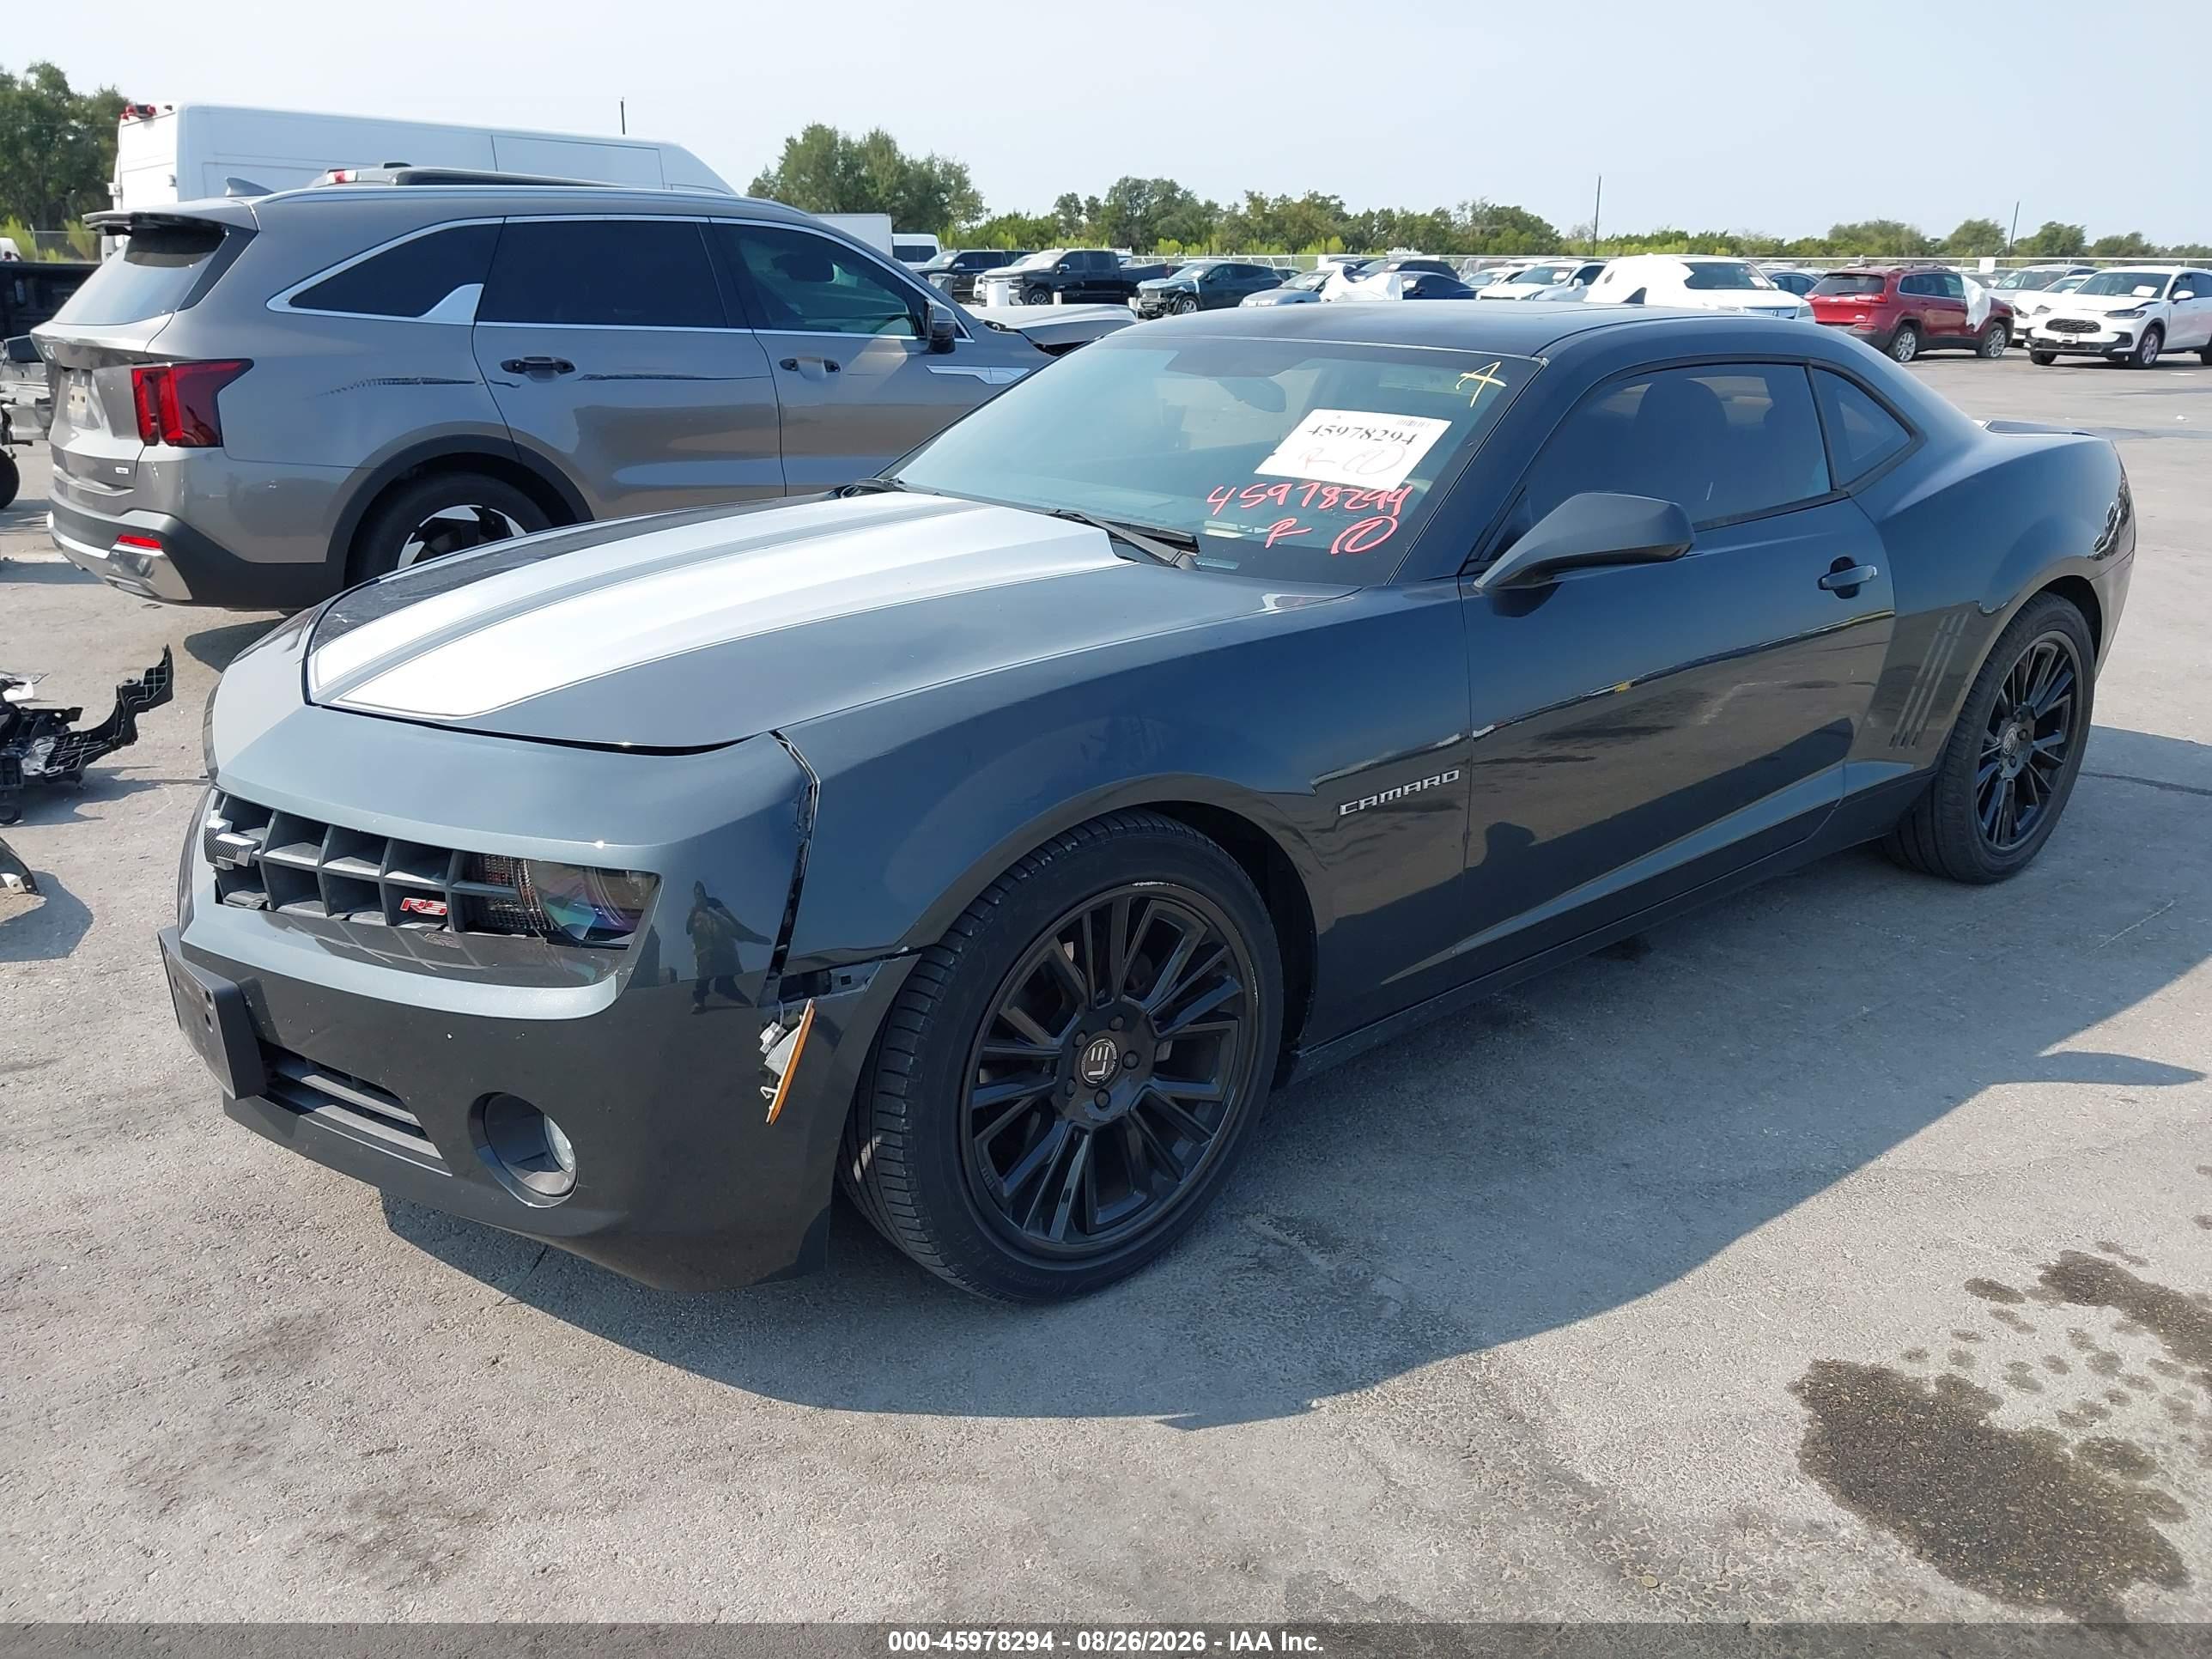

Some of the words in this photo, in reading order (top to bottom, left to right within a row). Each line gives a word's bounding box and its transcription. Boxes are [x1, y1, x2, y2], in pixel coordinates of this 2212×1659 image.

[1306, 424, 1418, 445] 45978294
[1206, 482, 1413, 516] 45978294
[1339, 769, 1460, 816] CAMARO
[399, 897, 447, 916] RS
